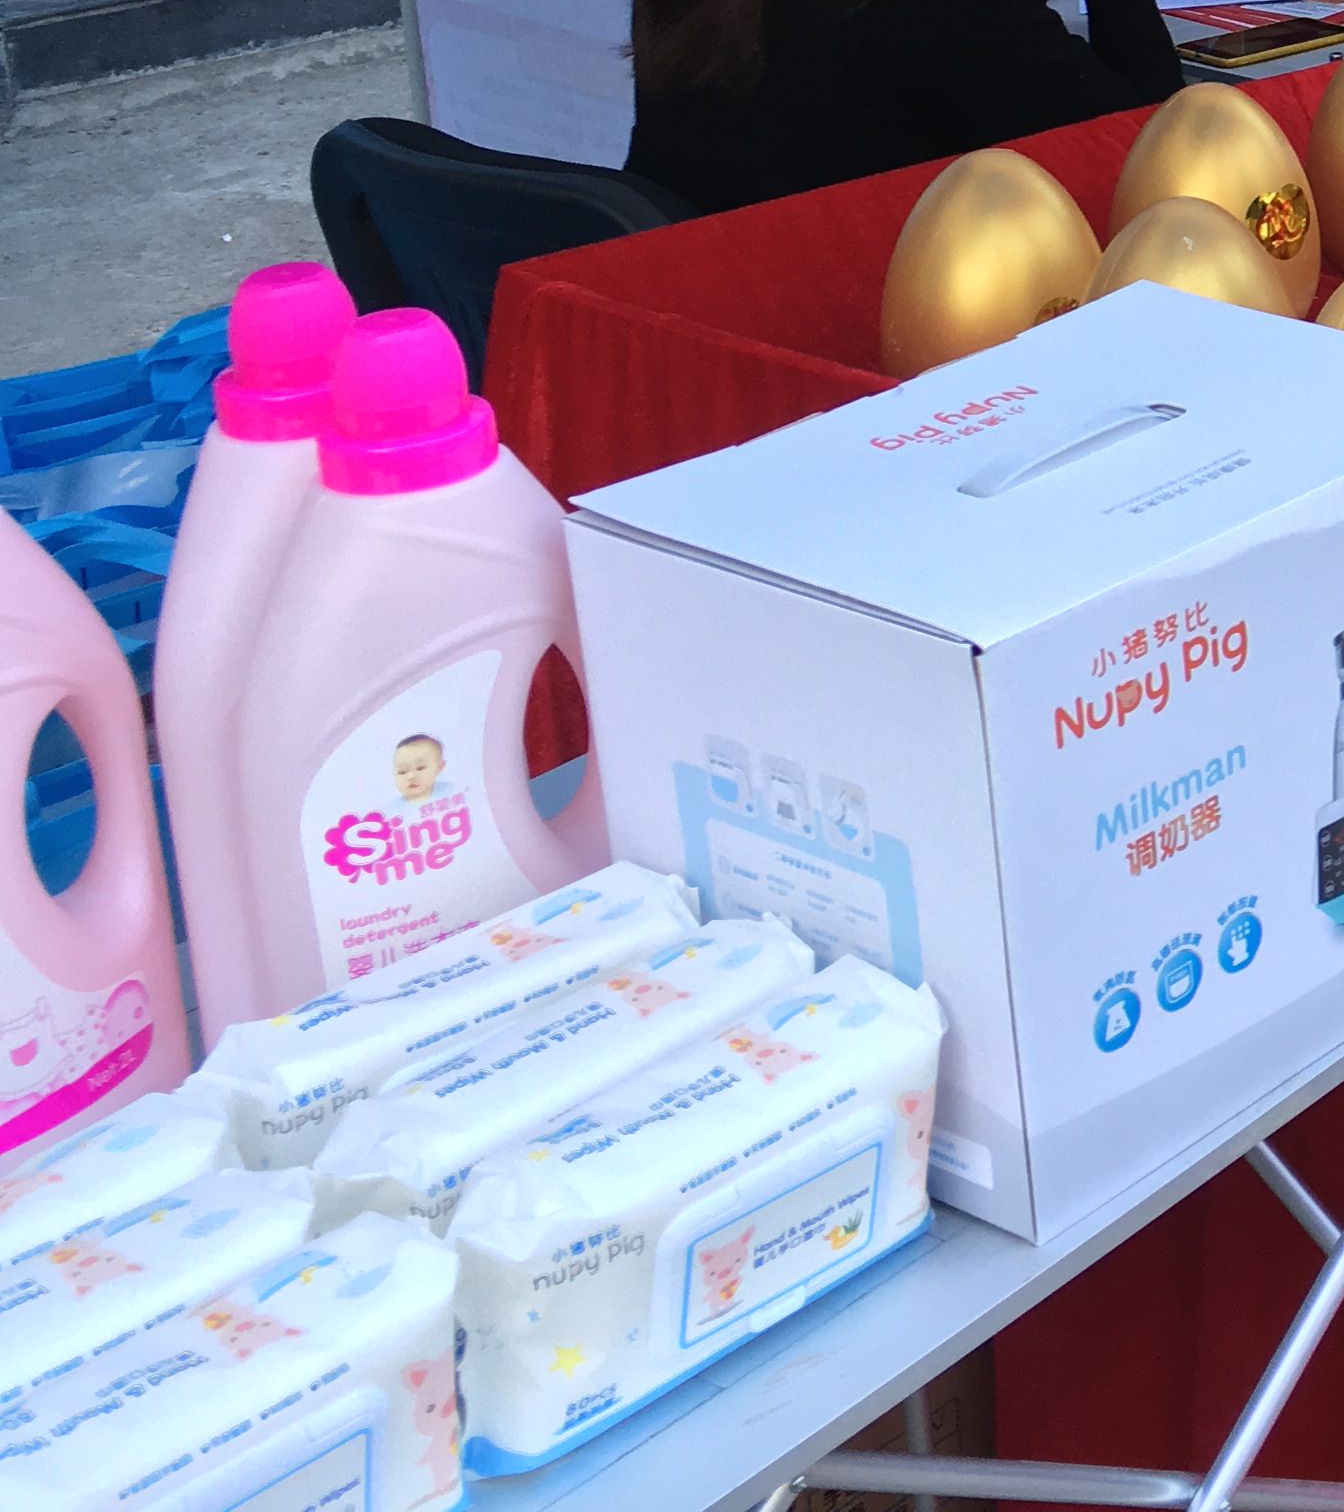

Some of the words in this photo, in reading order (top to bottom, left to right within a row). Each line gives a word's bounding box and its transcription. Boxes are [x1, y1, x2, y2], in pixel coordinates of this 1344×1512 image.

[1091, 600, 1210, 678] 小猪努比
[1054, 661, 1171, 750] Nupy
[1095, 744, 1247, 852] Milkman
[343, 805, 473, 866] Sing
[374, 842, 456, 886] me
[1125, 794, 1222, 877] 调奶器
[339, 903, 412, 931] laundry
[342, 910, 441, 950] detergent
[347, 919, 482, 981] 婴儿洗
[408, 1191, 461, 1220] nup
[752, 1228, 786, 1256] Hand
[799, 1205, 836, 1230] Mouth
[836, 1186, 871, 1210] Wipes
[531, 1251, 602, 1292] nupy
